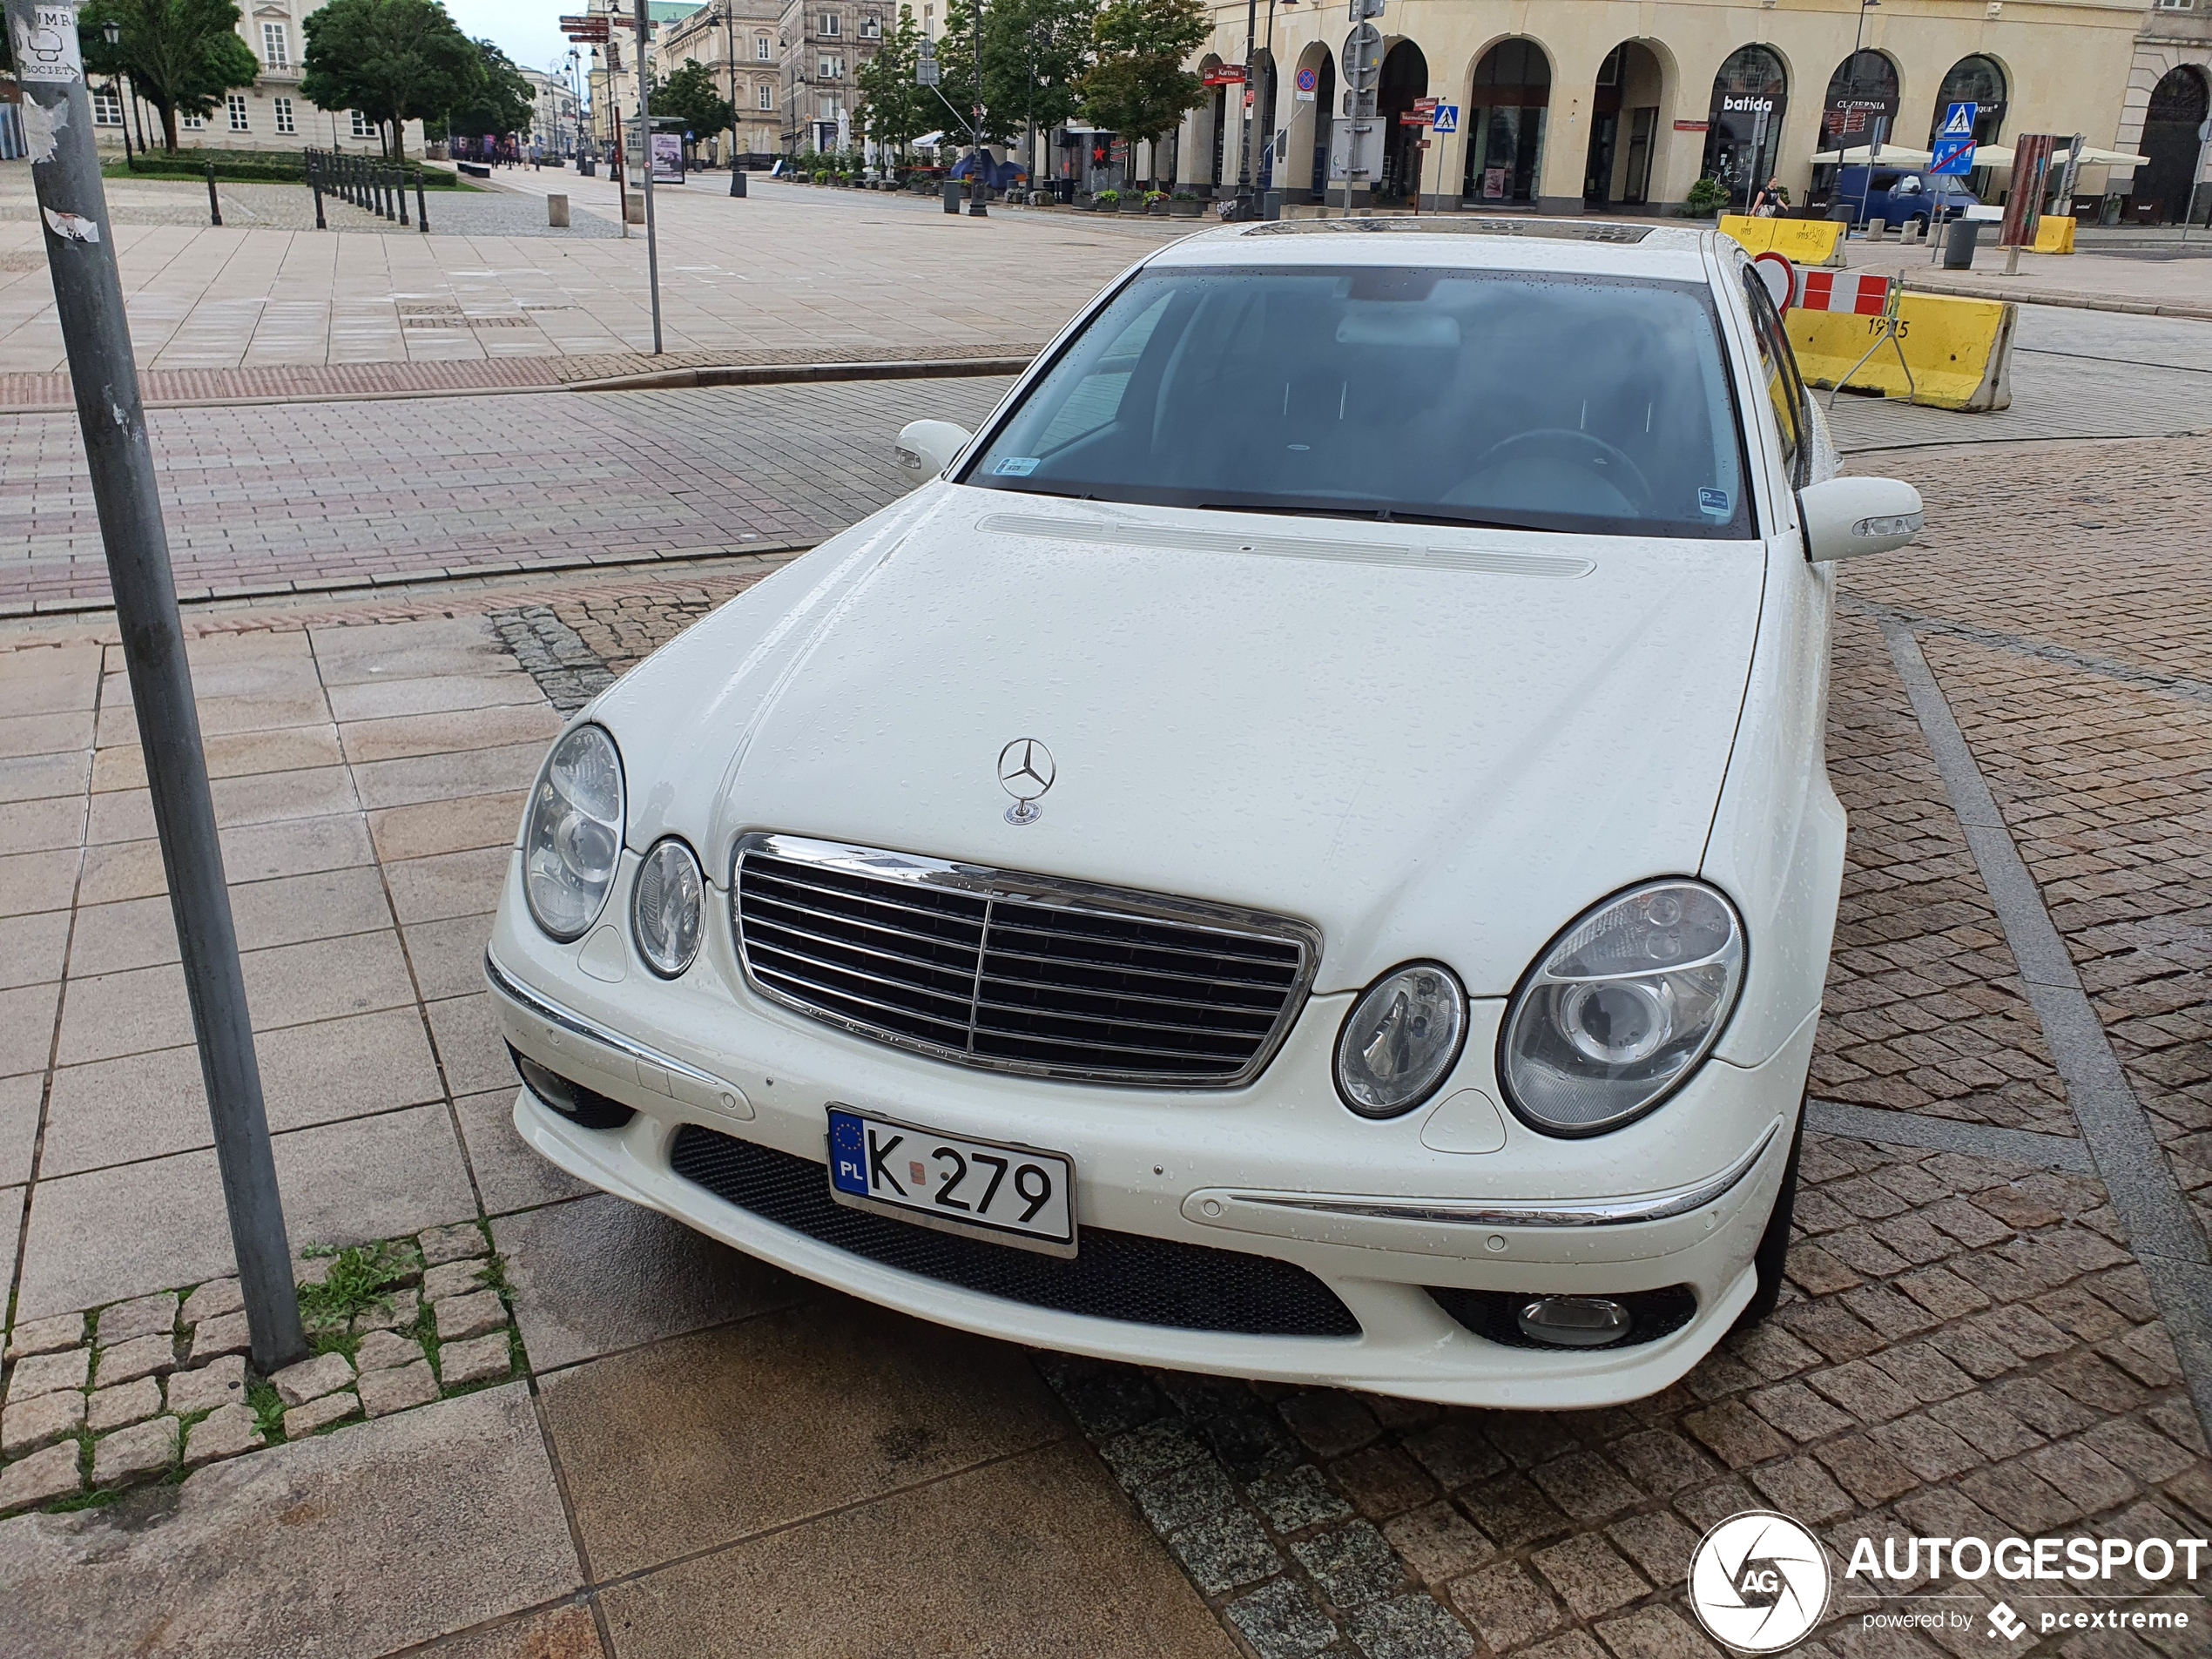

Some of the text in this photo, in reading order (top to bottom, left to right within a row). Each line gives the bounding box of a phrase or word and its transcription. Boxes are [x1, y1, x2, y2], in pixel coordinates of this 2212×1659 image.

[26, 65, 76, 76] SOCIET
[1723, 95, 1773, 111] batida
[1868, 317, 1910, 339] 1915
[840, 1160, 863, 1181] PL
[867, 1129, 1052, 1224] K 279
